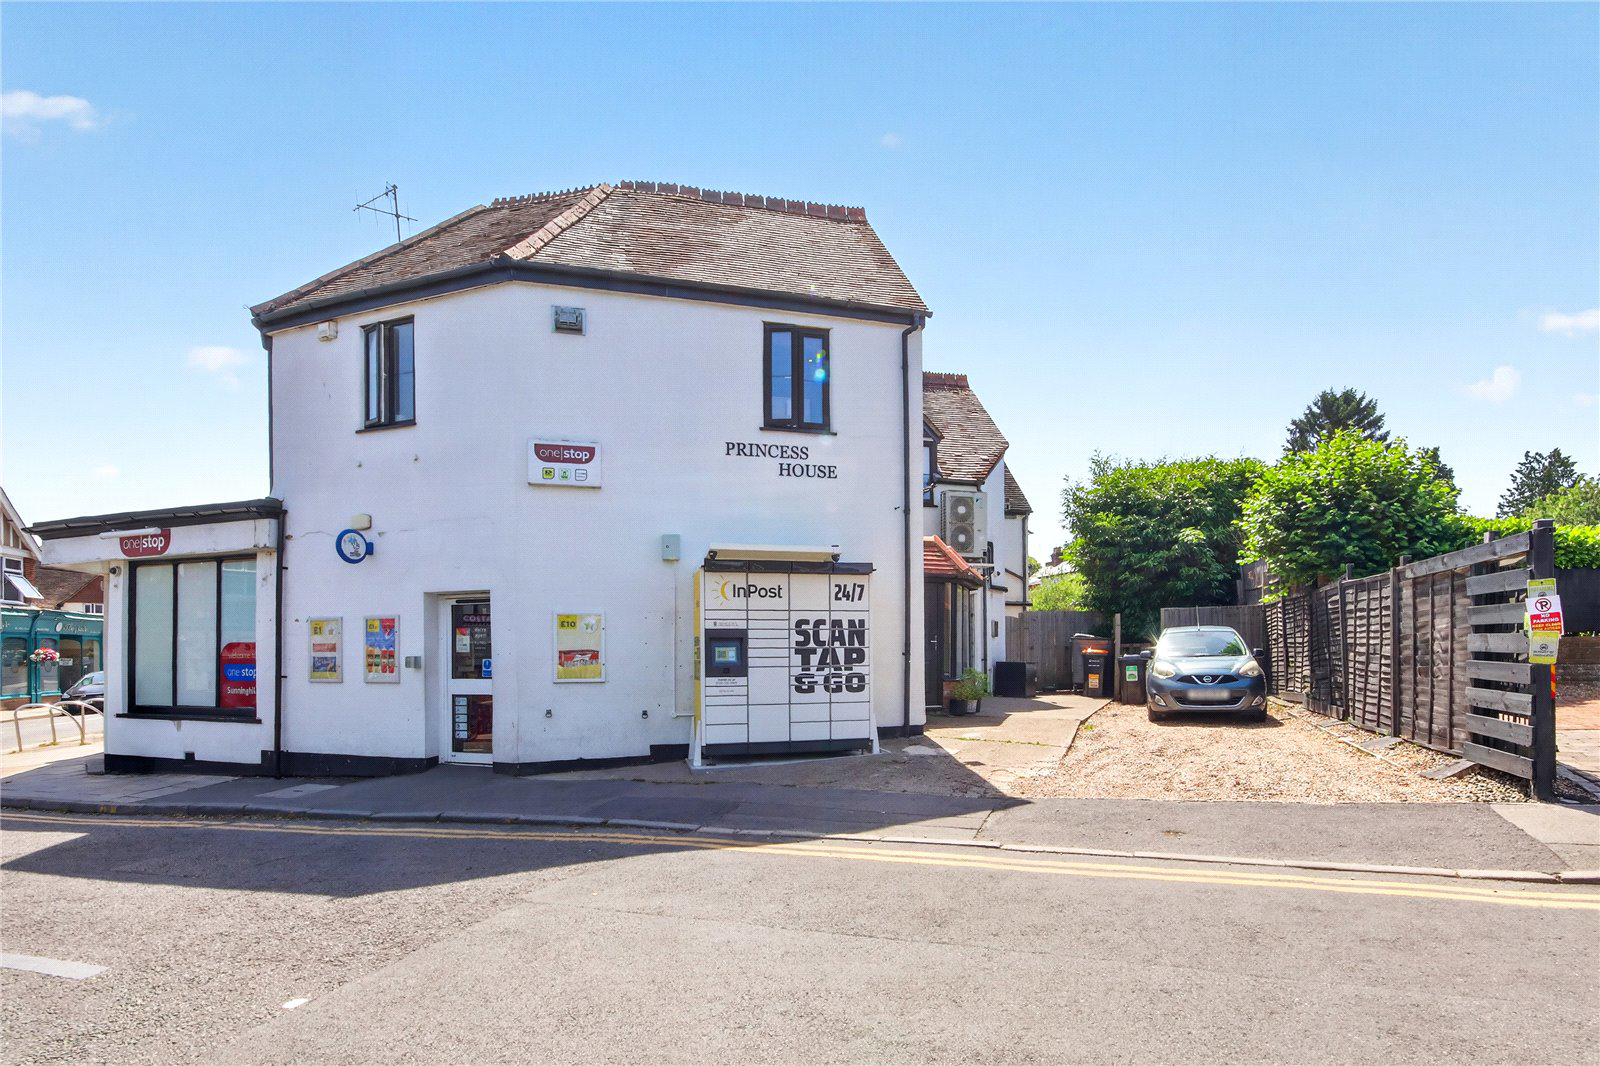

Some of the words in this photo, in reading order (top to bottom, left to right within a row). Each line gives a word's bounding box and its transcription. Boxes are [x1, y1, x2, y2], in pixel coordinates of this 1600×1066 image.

[563, 449, 590, 461] stop
[725, 442, 809, 460] PRINCESS
[779, 463, 838, 479] HOUSE
[142, 535, 165, 551] stop
[732, 584, 783, 599] InPost
[834, 583, 865, 602] 24/7
[795, 619, 865, 646] SCAN
[795, 647, 866, 672] TAP
[227, 686, 257, 697] Sunninghil
